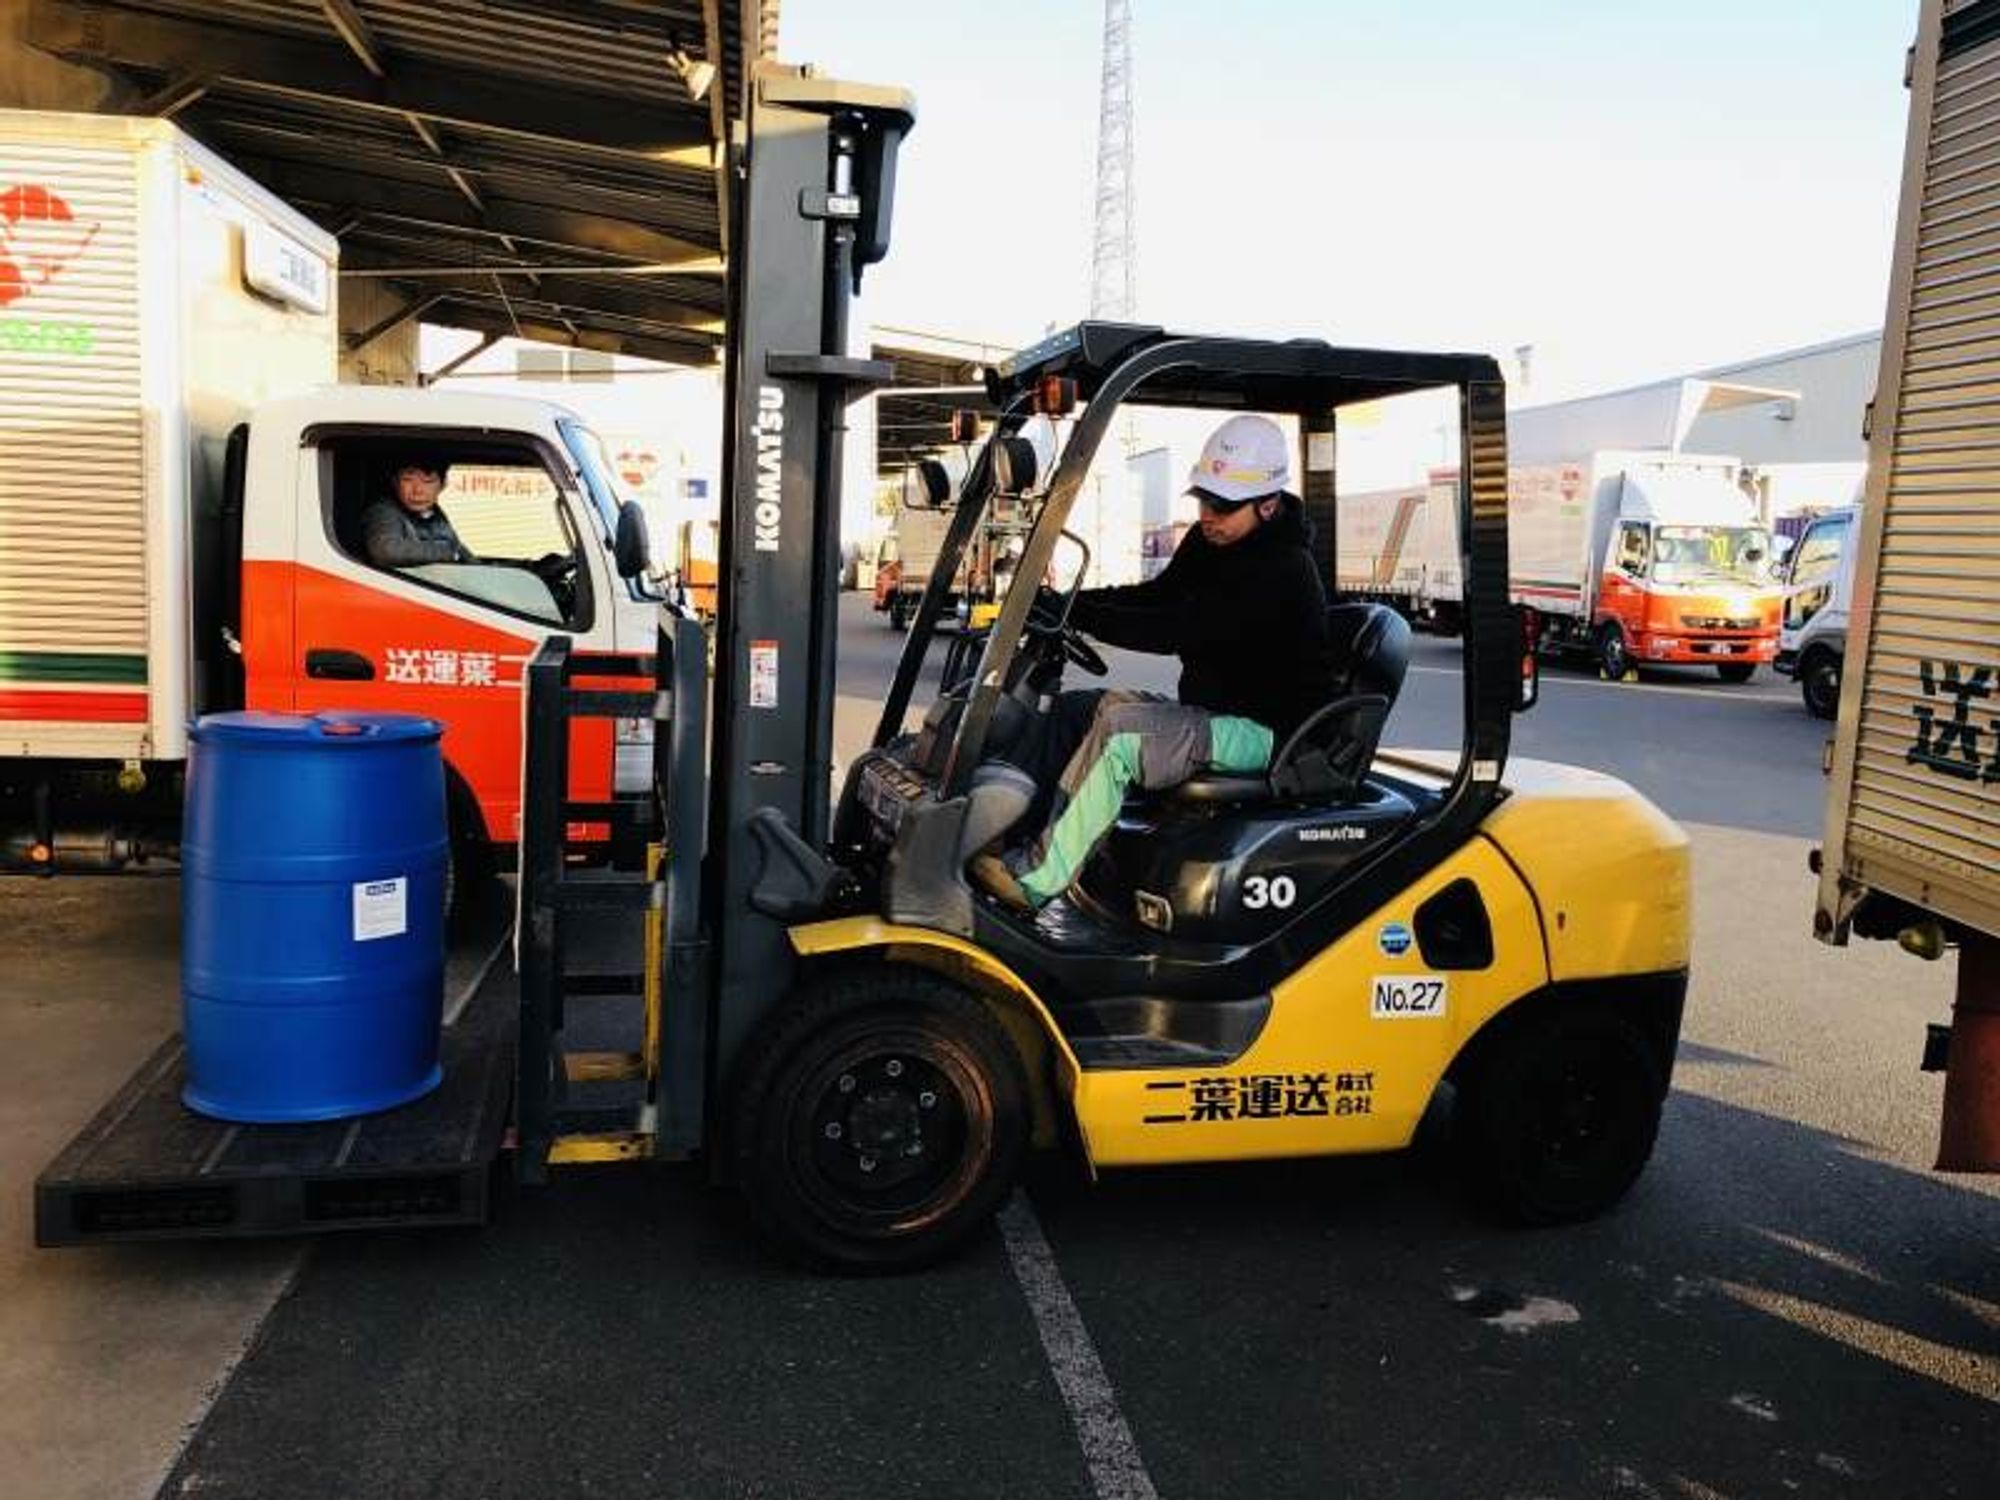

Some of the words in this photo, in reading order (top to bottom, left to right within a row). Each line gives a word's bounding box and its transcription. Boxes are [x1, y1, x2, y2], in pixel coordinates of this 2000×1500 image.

[750, 385, 784, 552] KOMATSU
[1241, 876, 1297, 909] 30
[1375, 982, 1444, 1012] No.27
[1143, 1072, 1330, 1123] 二葉運送
